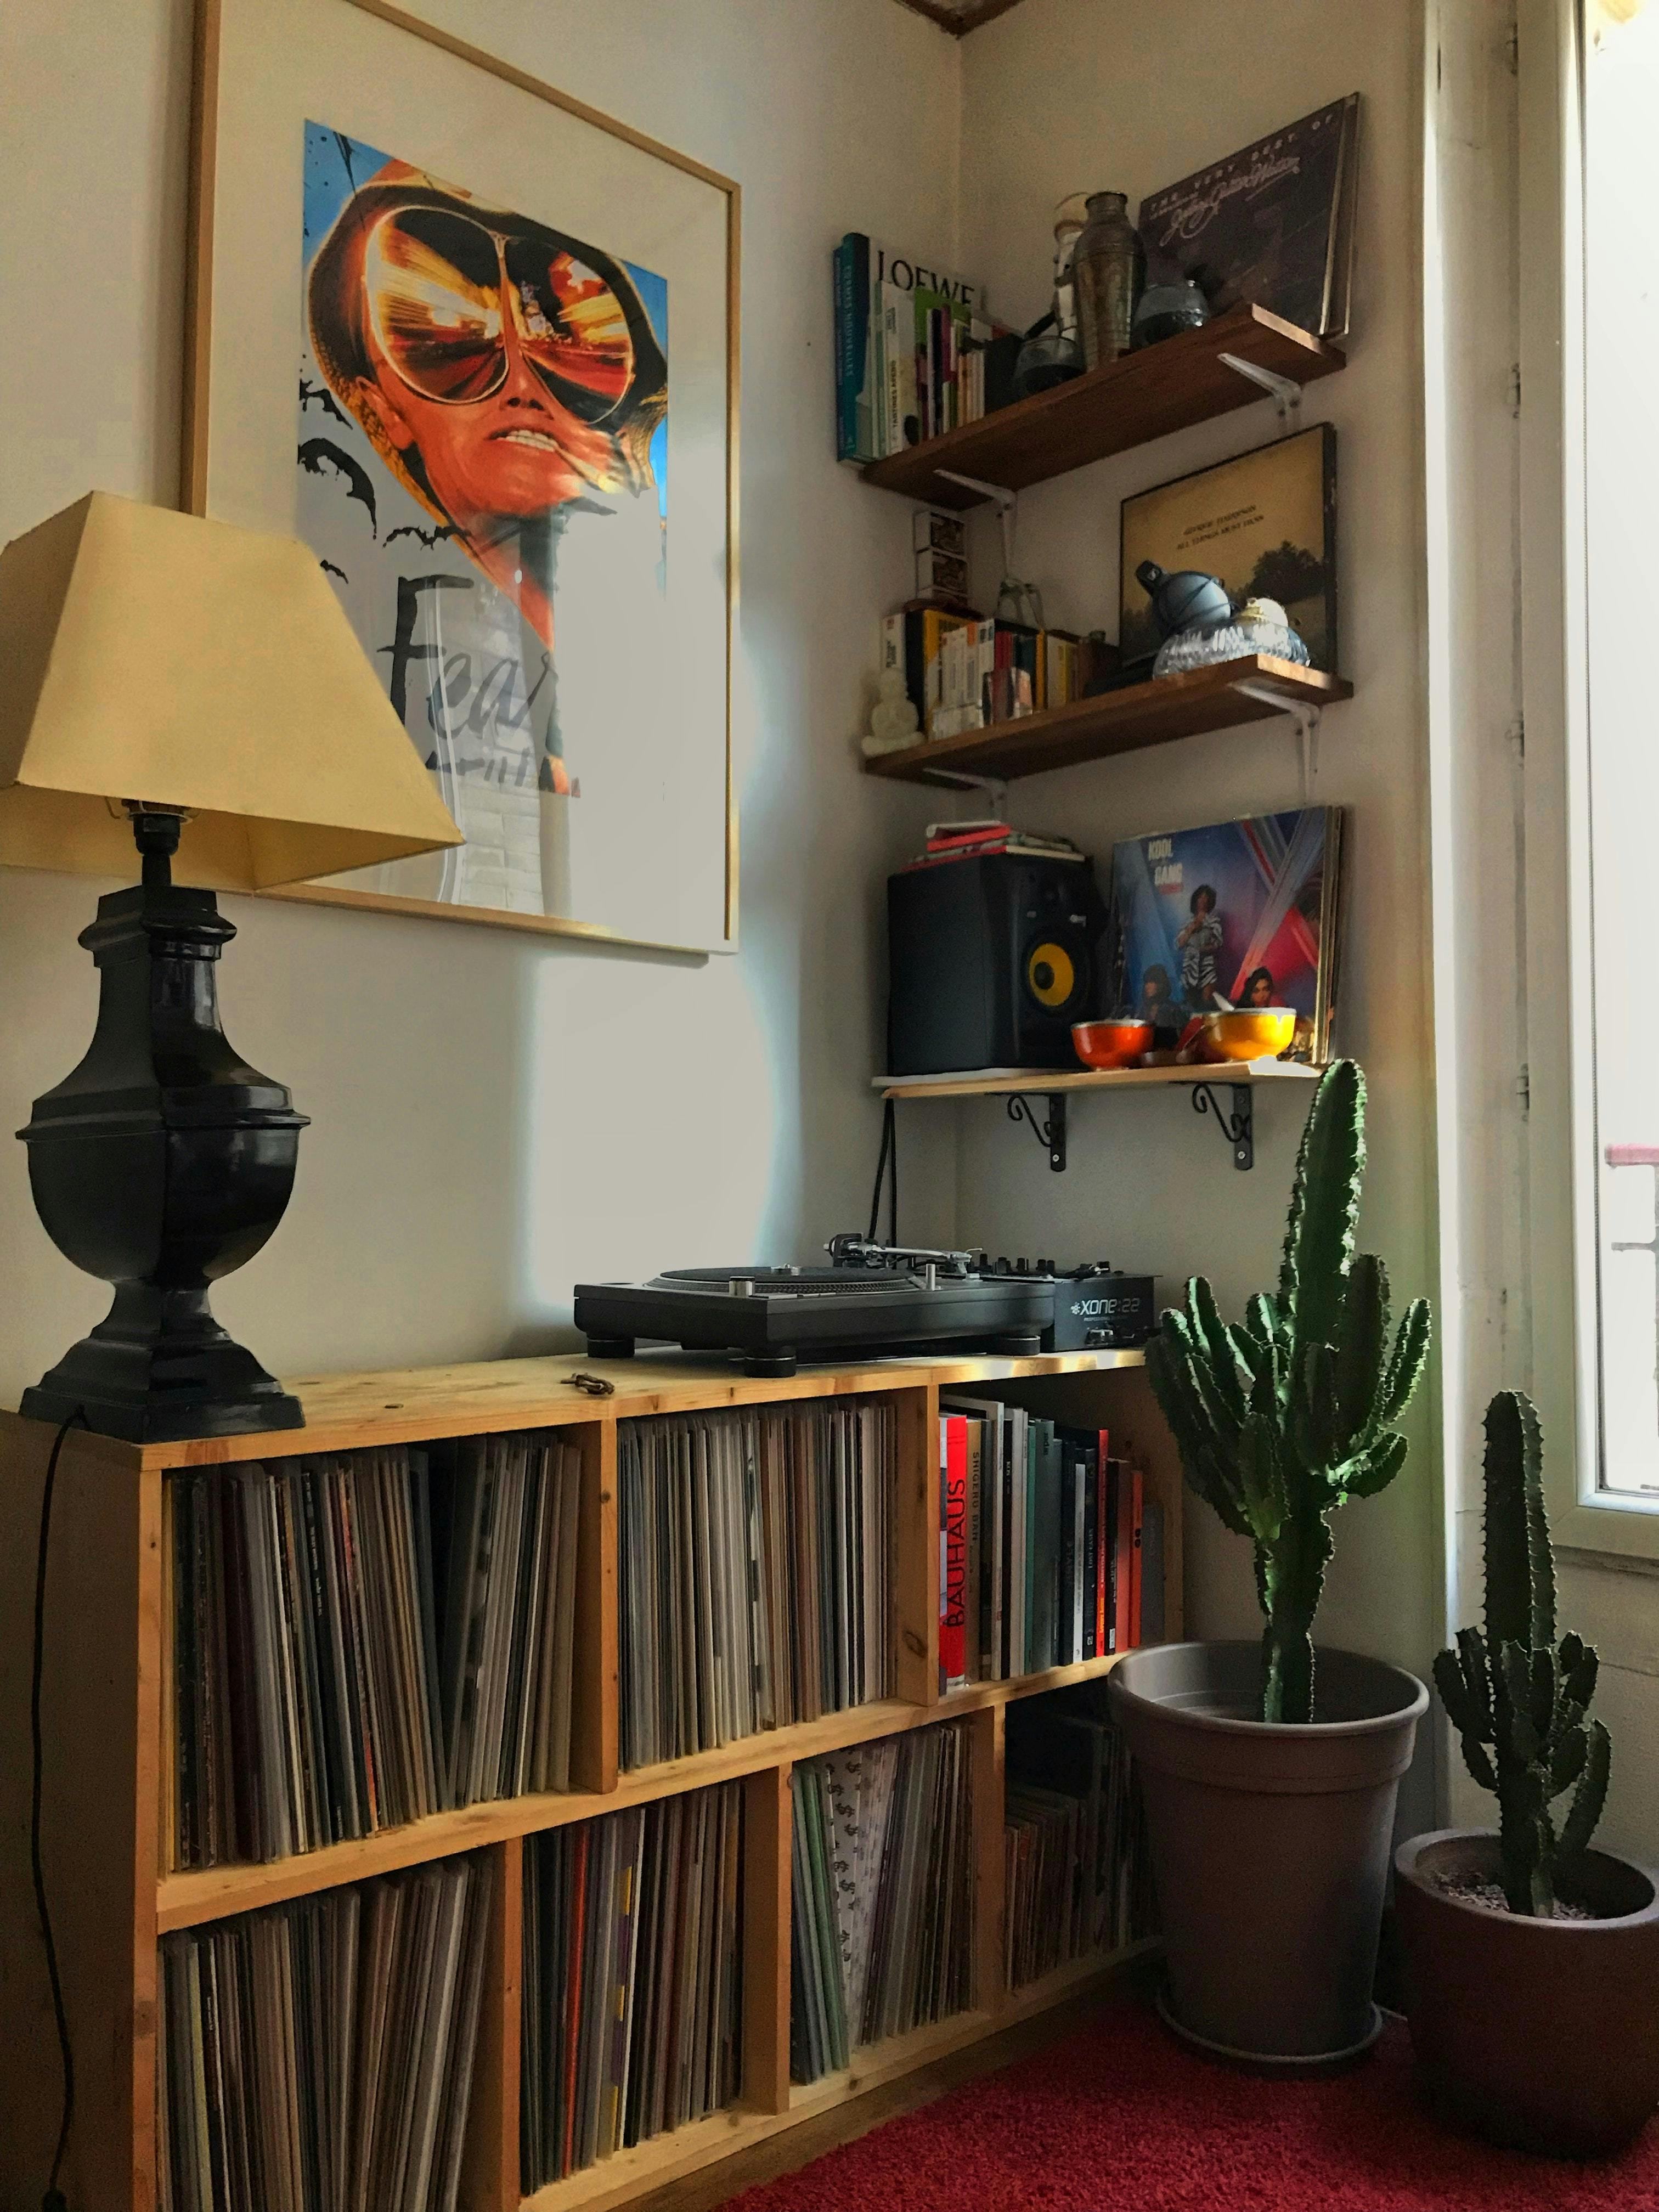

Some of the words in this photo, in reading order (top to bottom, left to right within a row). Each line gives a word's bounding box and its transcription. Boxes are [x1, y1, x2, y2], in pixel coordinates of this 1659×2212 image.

[877, 250, 975, 304] LOEWE
[377, 574, 562, 744] Fear
[947, 1479, 965, 1628] BAUHAUS
